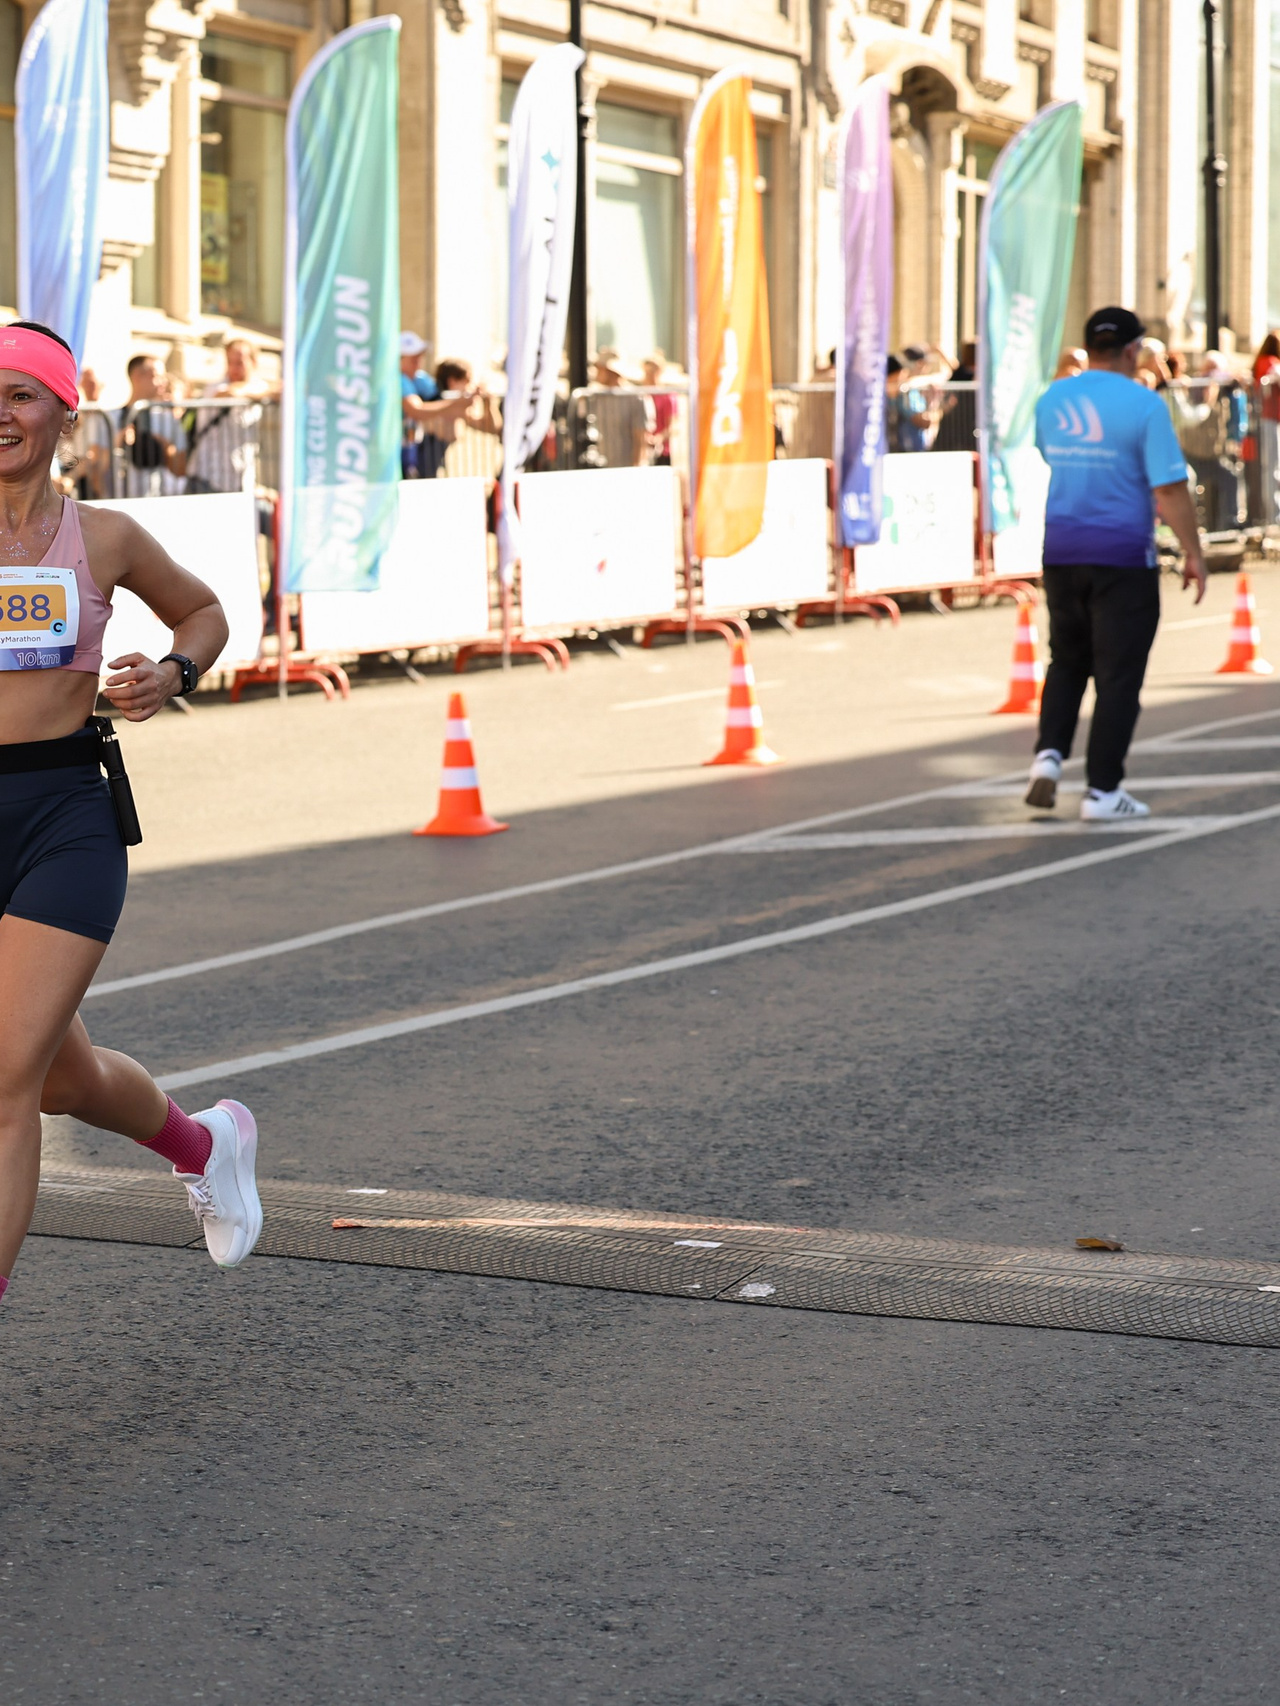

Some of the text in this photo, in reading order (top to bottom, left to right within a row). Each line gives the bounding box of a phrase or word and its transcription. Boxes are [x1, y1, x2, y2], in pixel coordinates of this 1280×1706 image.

[711, 328, 742, 448] DN
[53, 622, 63, 633] C
[17, 651, 60, 666] 10km
